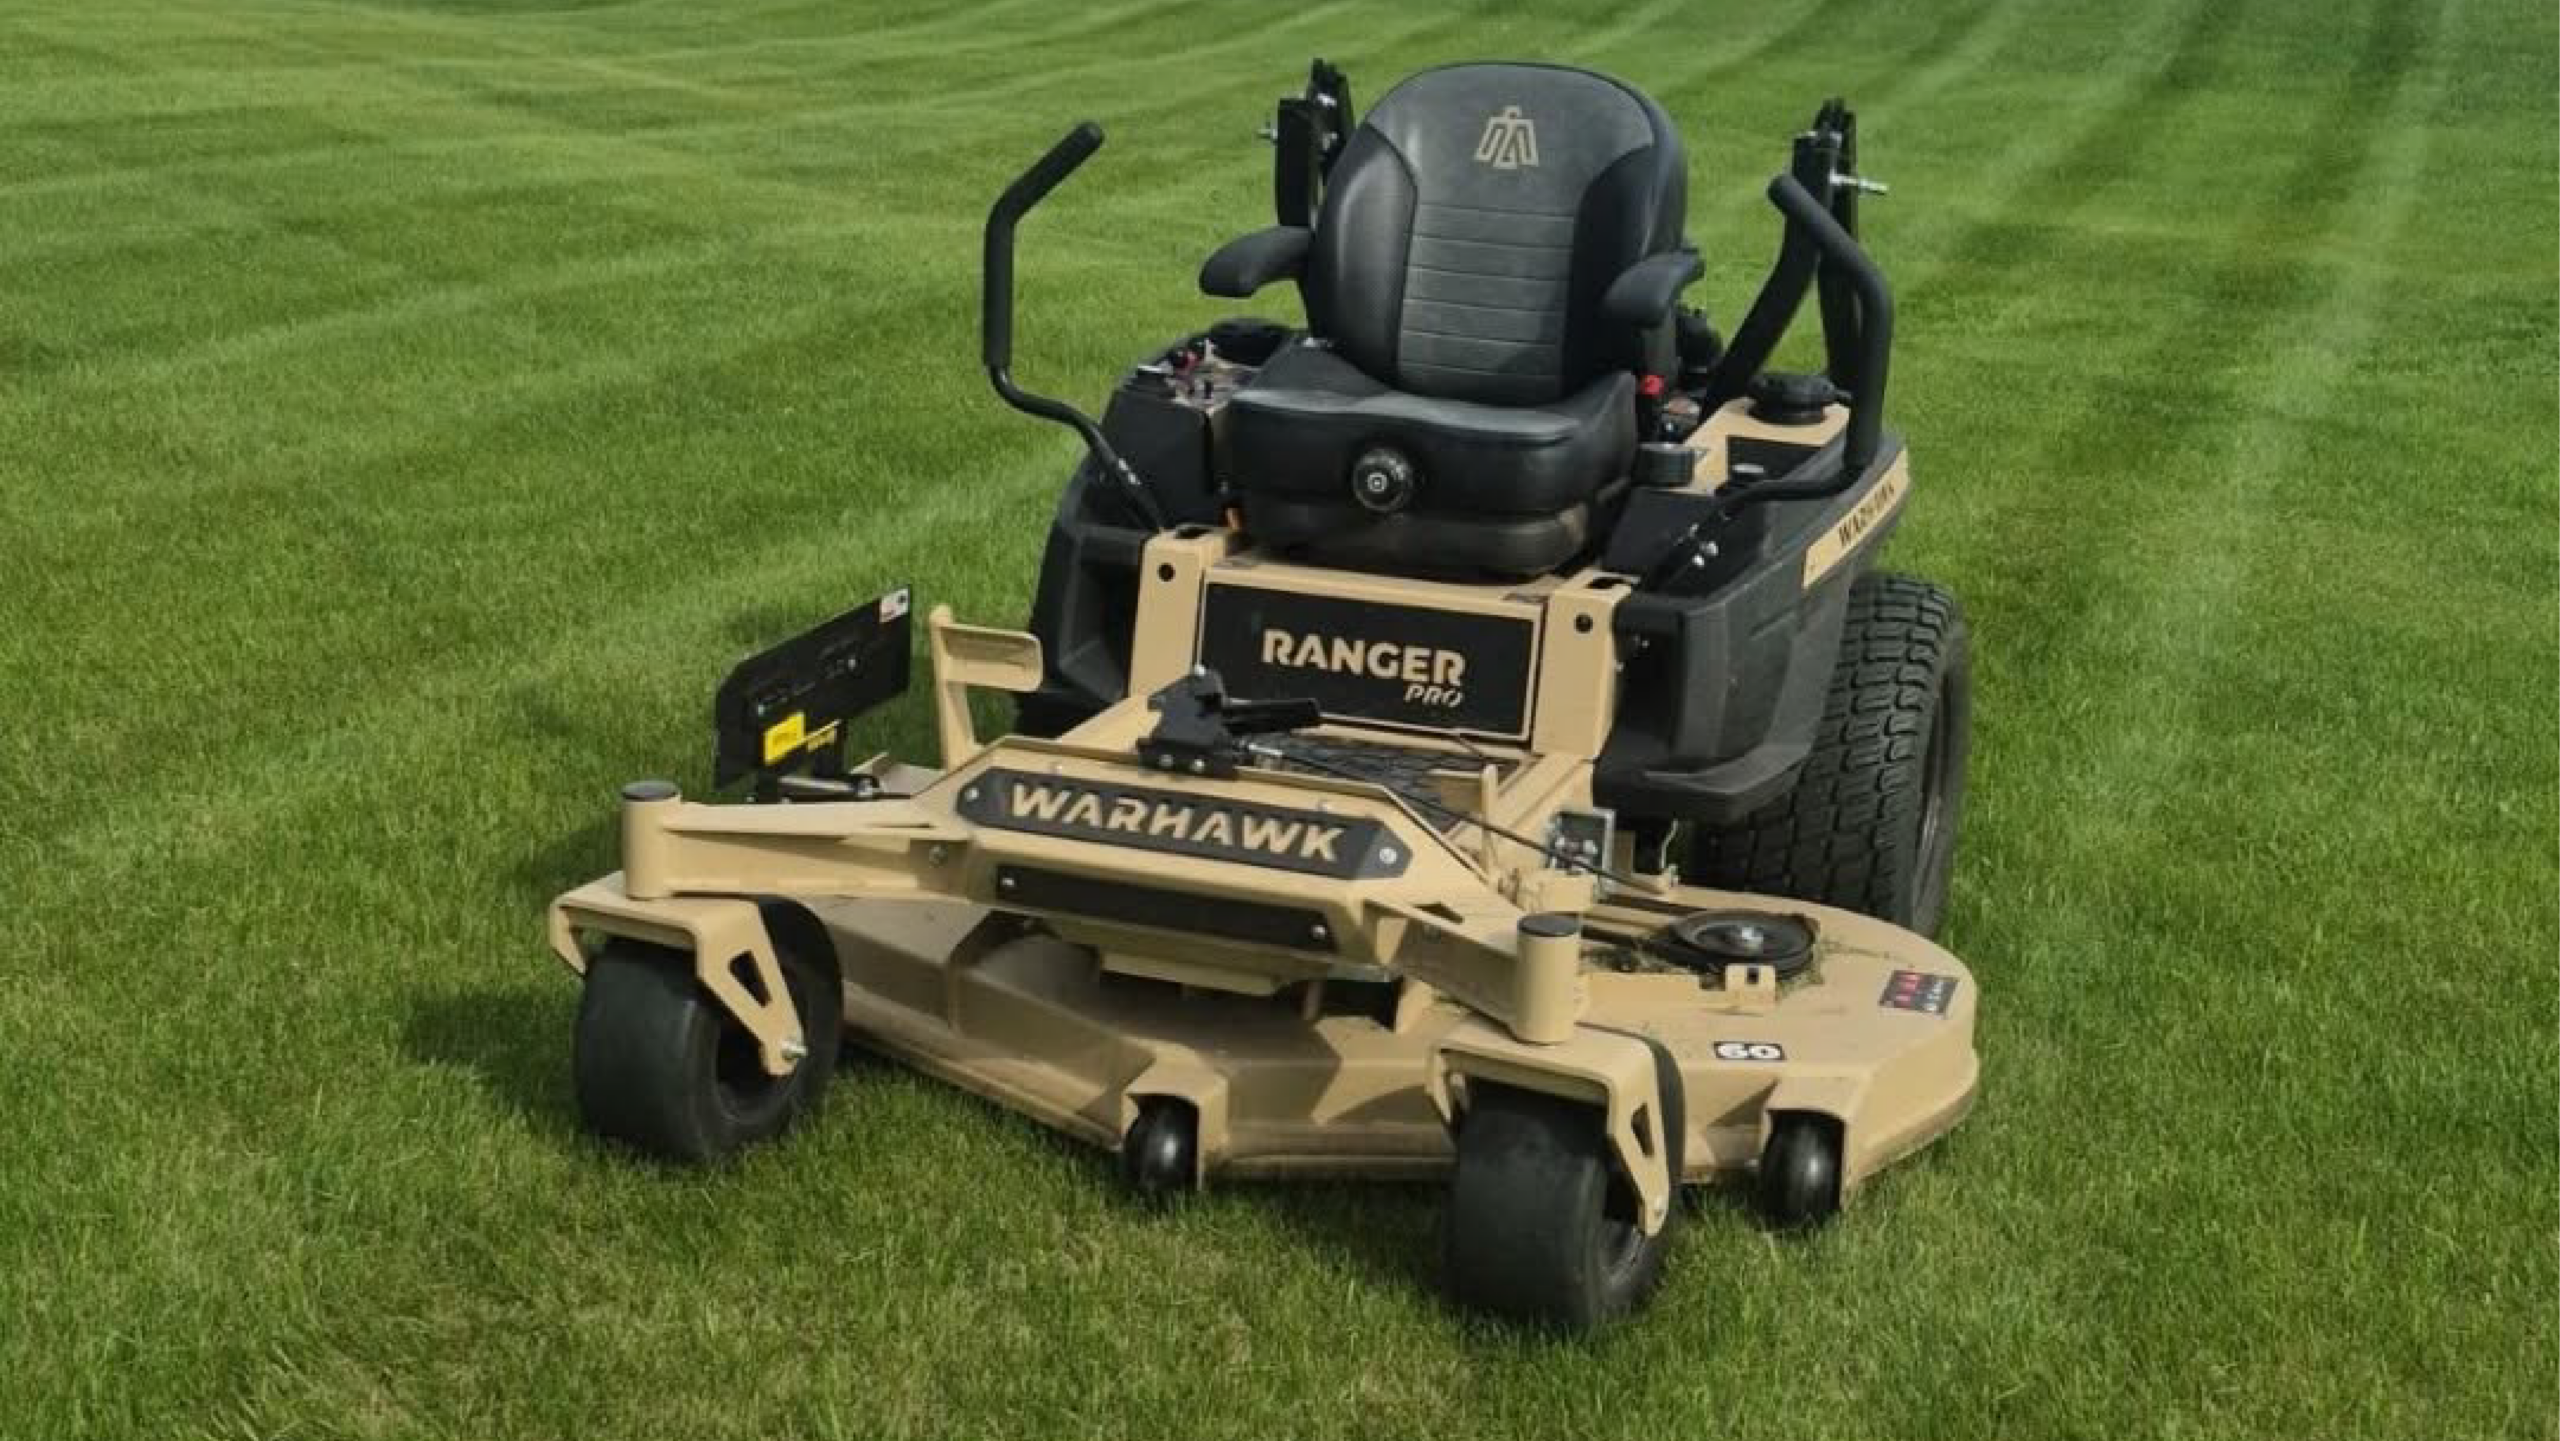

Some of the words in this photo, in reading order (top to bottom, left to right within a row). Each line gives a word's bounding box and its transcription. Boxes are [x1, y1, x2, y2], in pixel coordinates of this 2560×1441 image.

[1263, 629, 1465, 685] RANGER
[1404, 685, 1463, 707] PRO
[1012, 783, 1345, 861] WARHAWK
[1716, 1043, 1781, 1059] 60
